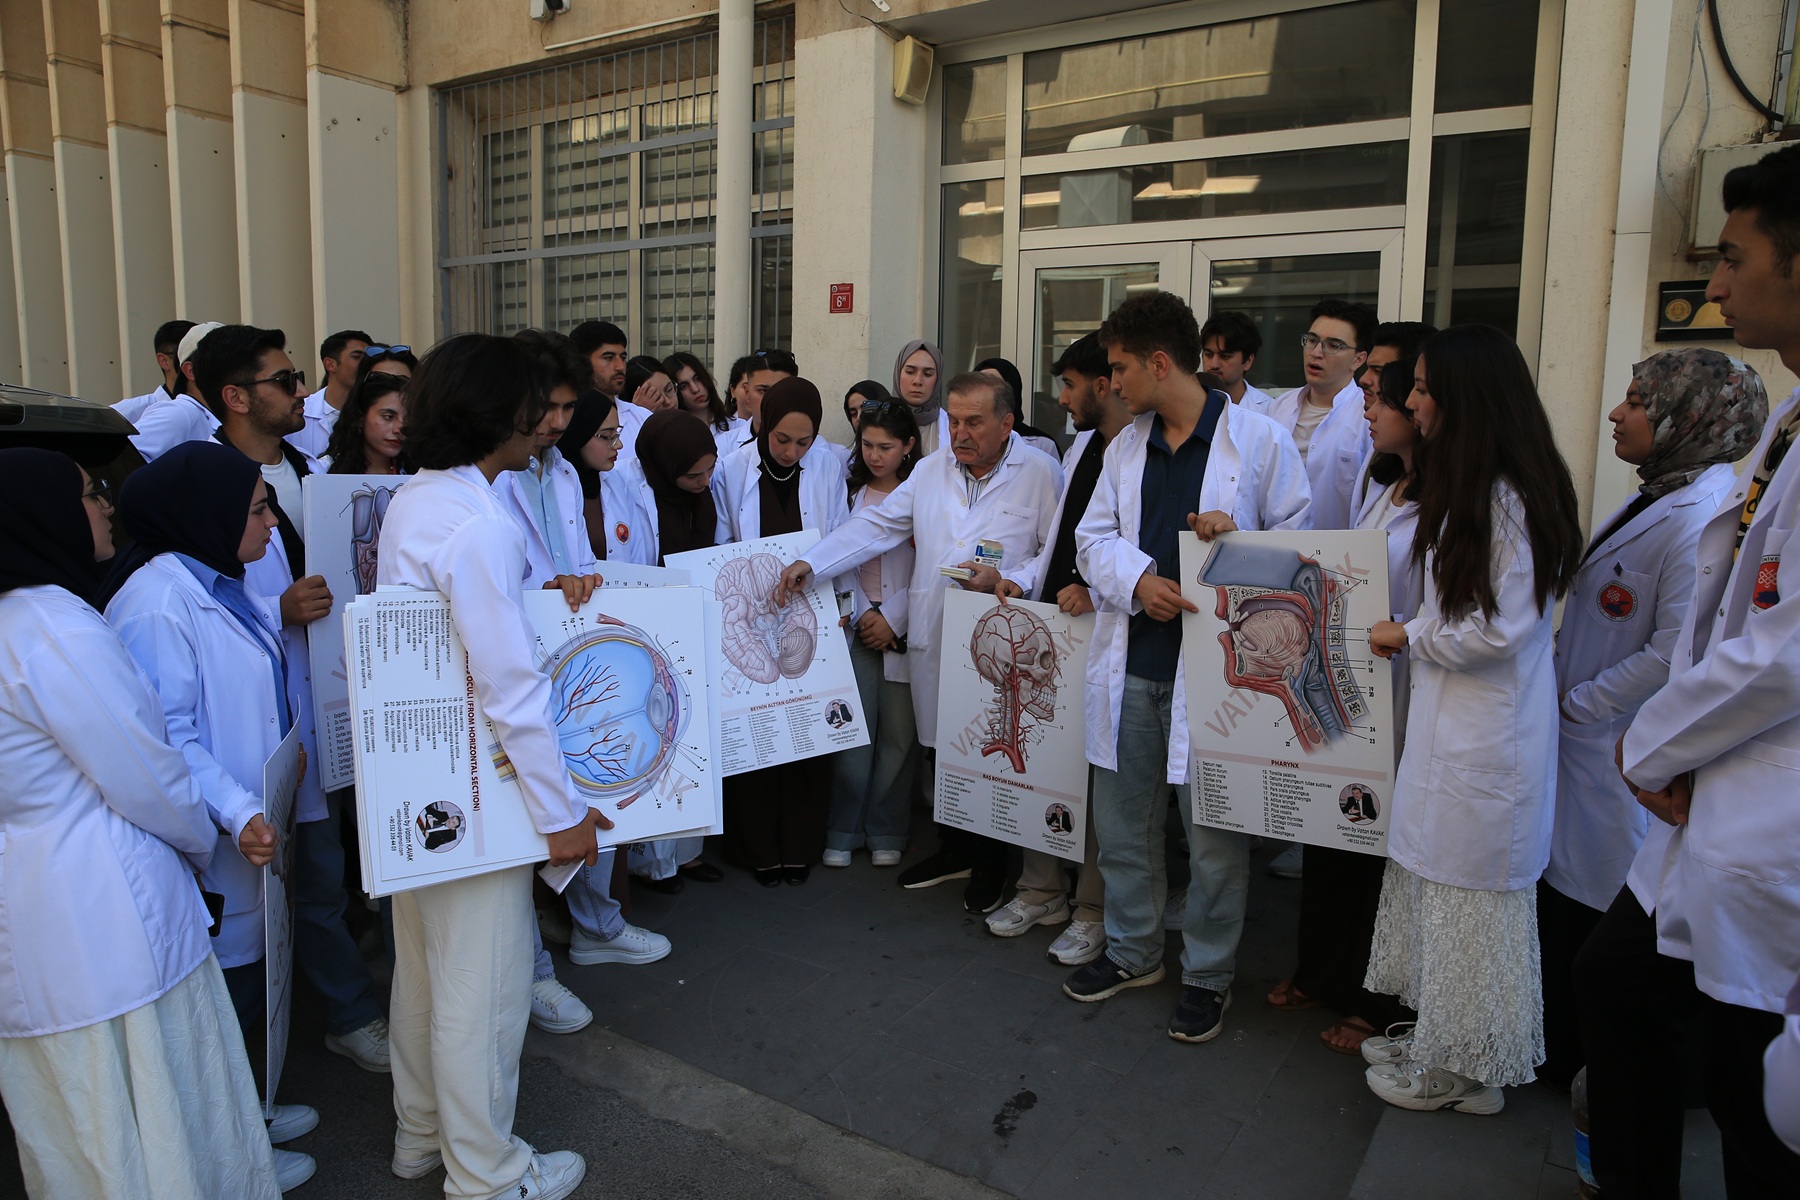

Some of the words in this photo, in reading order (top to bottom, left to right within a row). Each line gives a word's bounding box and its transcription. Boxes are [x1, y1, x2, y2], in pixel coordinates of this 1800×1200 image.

[466, 700, 475, 725] (FROM
[785, 694, 812, 704] GÖRÜNÜMÜ
[1204, 689, 1260, 738] VAT
[950, 707, 999, 756] VATA
[468, 726, 478, 775] HORIZONTAL
[1271, 760, 1299, 769] PHARYNX
[471, 776, 480, 812] SECTION)
[992, 776, 1007, 784] BOYUN
[1008, 780, 1034, 791] DAMARLARI
